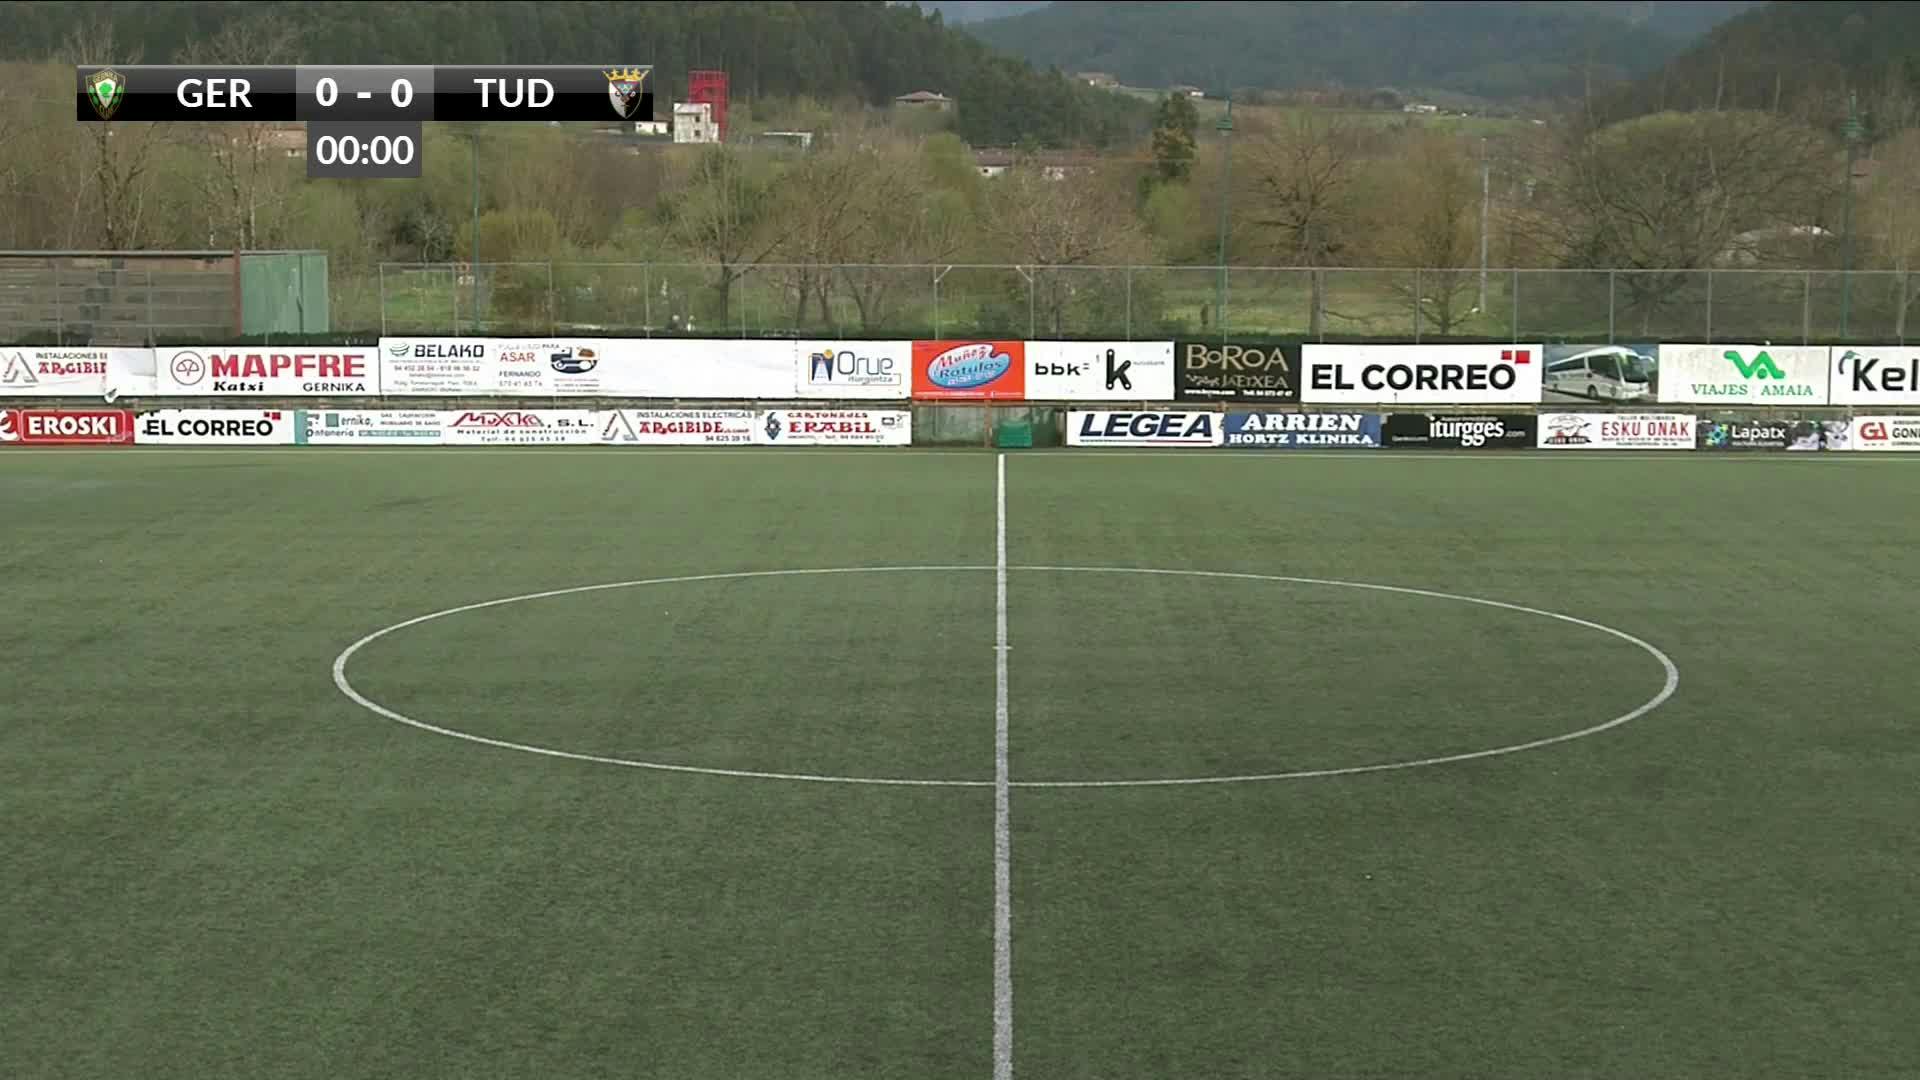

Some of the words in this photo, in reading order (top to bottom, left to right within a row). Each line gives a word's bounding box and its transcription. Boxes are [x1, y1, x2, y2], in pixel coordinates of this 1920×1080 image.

[415, 345, 484, 358] BELAKO
[500, 352, 535, 362] ASAR
[211, 354, 365, 377] MAPFRE
[837, 351, 893, 375] Orue
[1035, 363, 1081, 376] bbk
[1311, 364, 1355, 390] EL
[1361, 363, 1516, 390] CORREO
[213, 381, 264, 391] Katxi
[303, 382, 365, 392] GERNIKA
[1691, 383, 1748, 395] VIAJES
[1761, 384, 1814, 396] AMAIA
[29, 416, 117, 435] EROSKI
[147, 419, 173, 435] EL
[178, 419, 273, 436] CORREO
[1080, 413, 1213, 437] LEGEA
[1241, 414, 1363, 431] ARRIEN
[1601, 421, 1641, 436] ESKU
[1648, 421, 1689, 436] ONAK
[1229, 433, 1290, 444] HORTZ
[1295, 433, 1374, 444] KLINIKA
